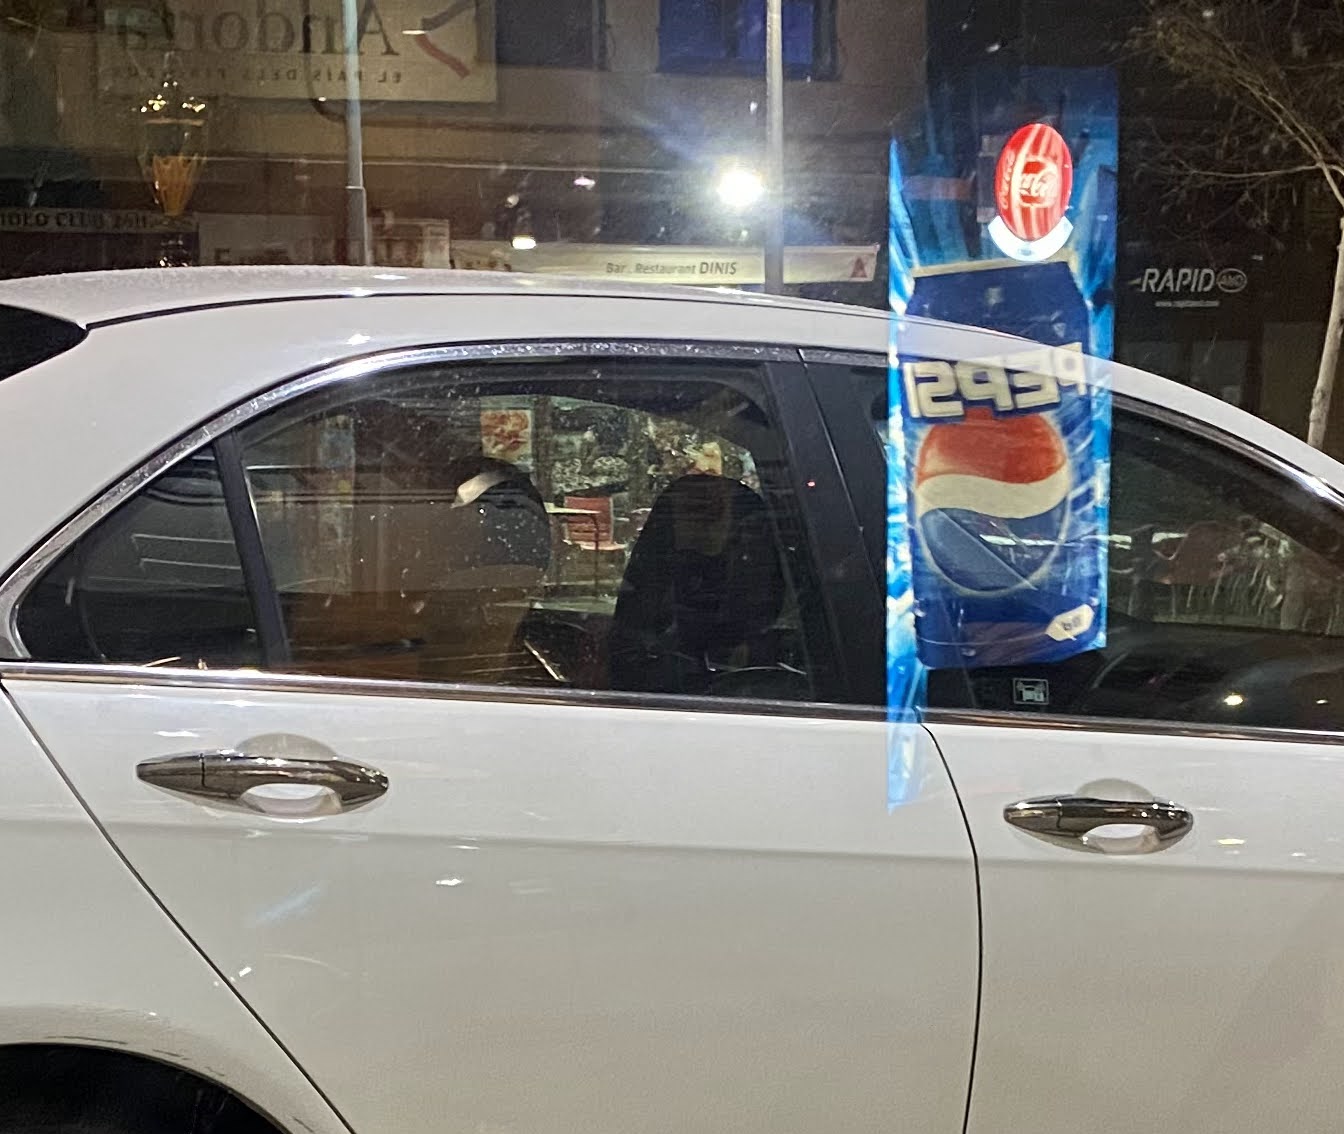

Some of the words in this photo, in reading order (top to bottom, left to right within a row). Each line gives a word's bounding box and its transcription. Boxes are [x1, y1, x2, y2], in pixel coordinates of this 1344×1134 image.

[636, 262, 697, 274] Restaurant
[699, 261, 738, 275] DINIS
[1140, 267, 1216, 293] RAPID
